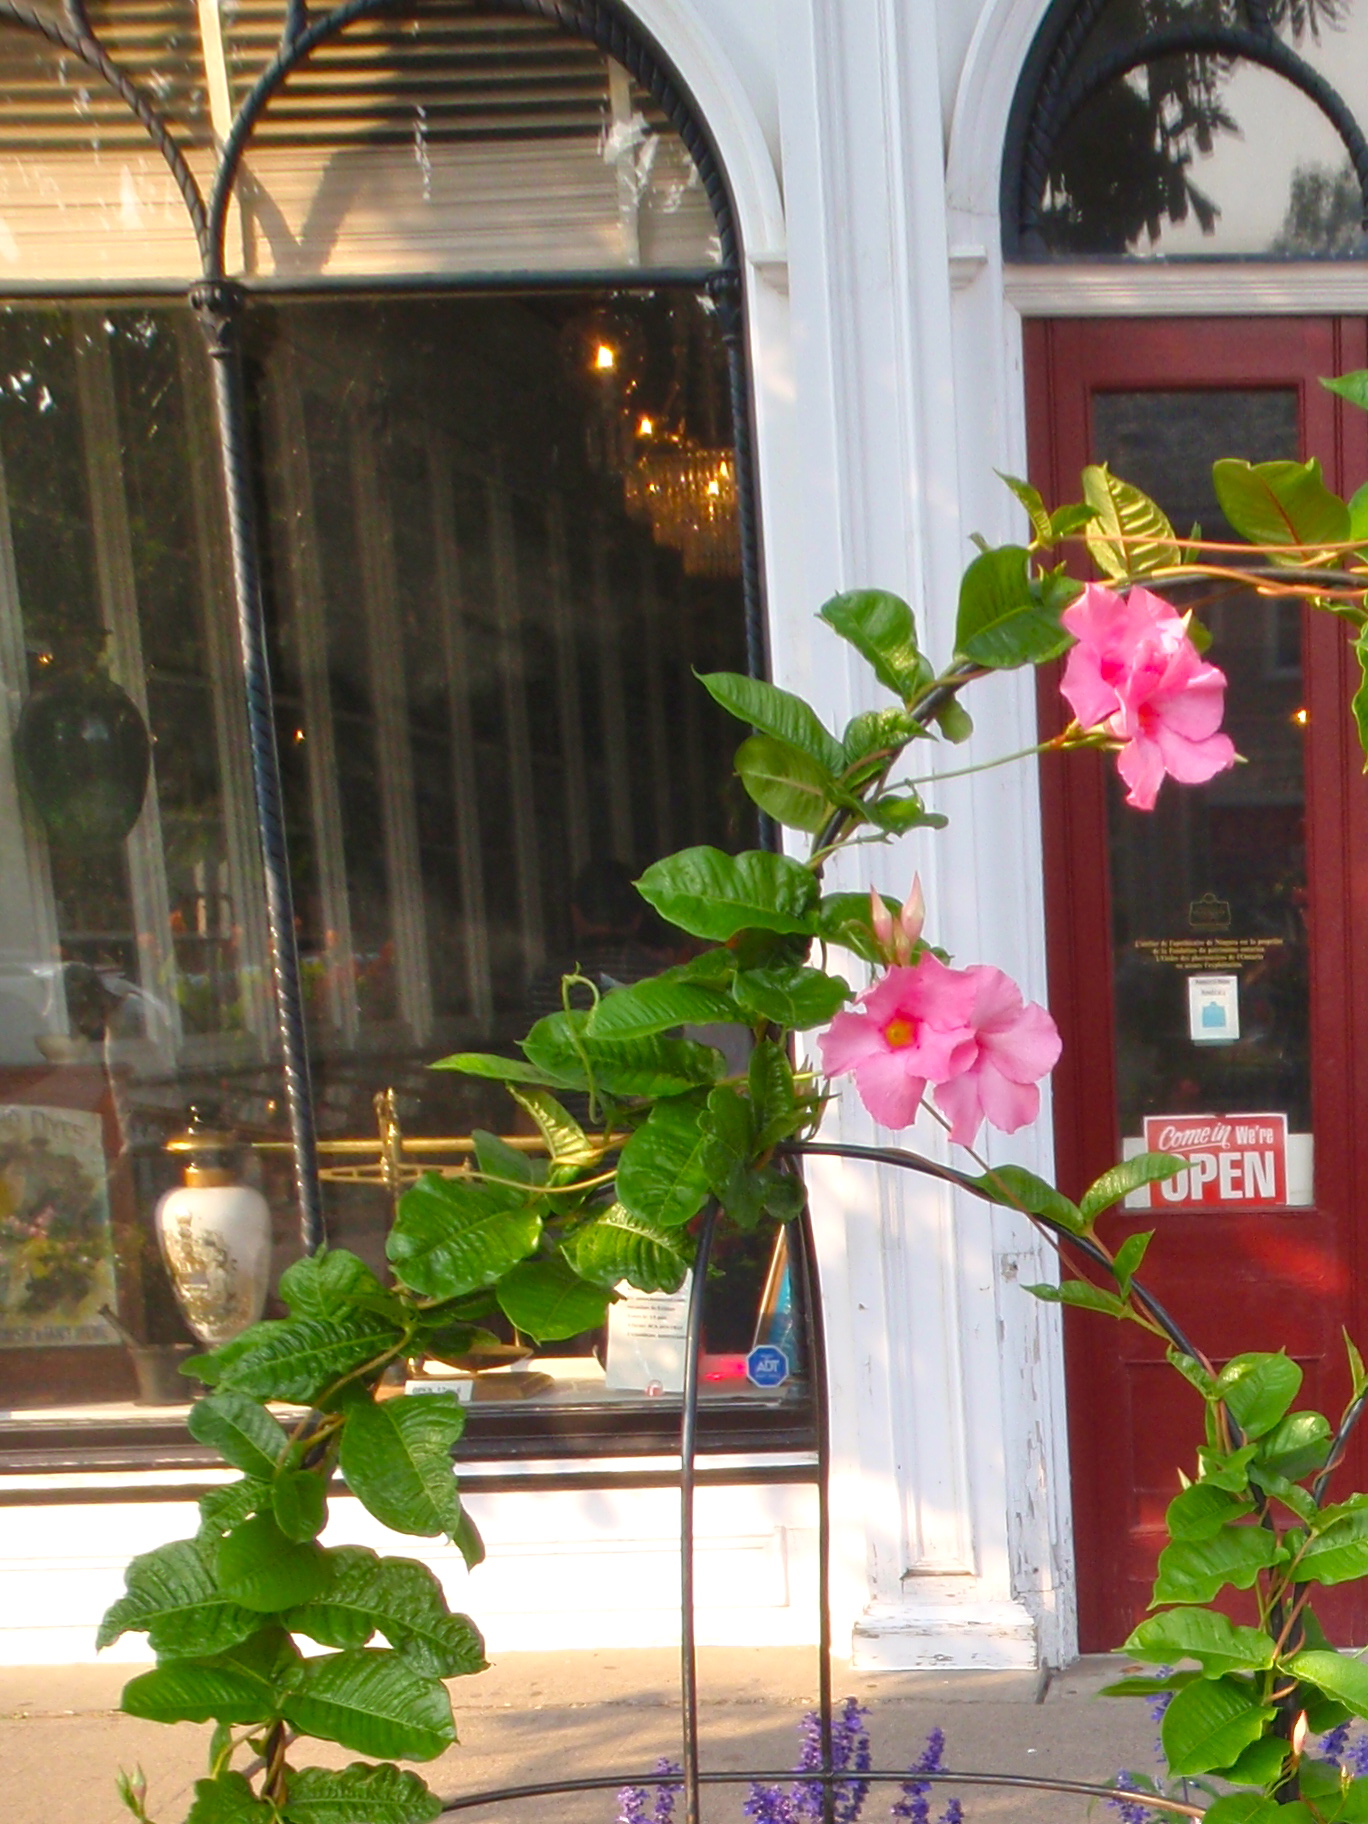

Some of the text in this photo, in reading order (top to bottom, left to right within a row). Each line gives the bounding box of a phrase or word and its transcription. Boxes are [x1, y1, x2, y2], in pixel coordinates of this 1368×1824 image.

[1158, 1122, 1274, 1151] Come in We're
[1160, 1150, 1276, 1202] OPEN
[756, 1359, 780, 1373] ADT
